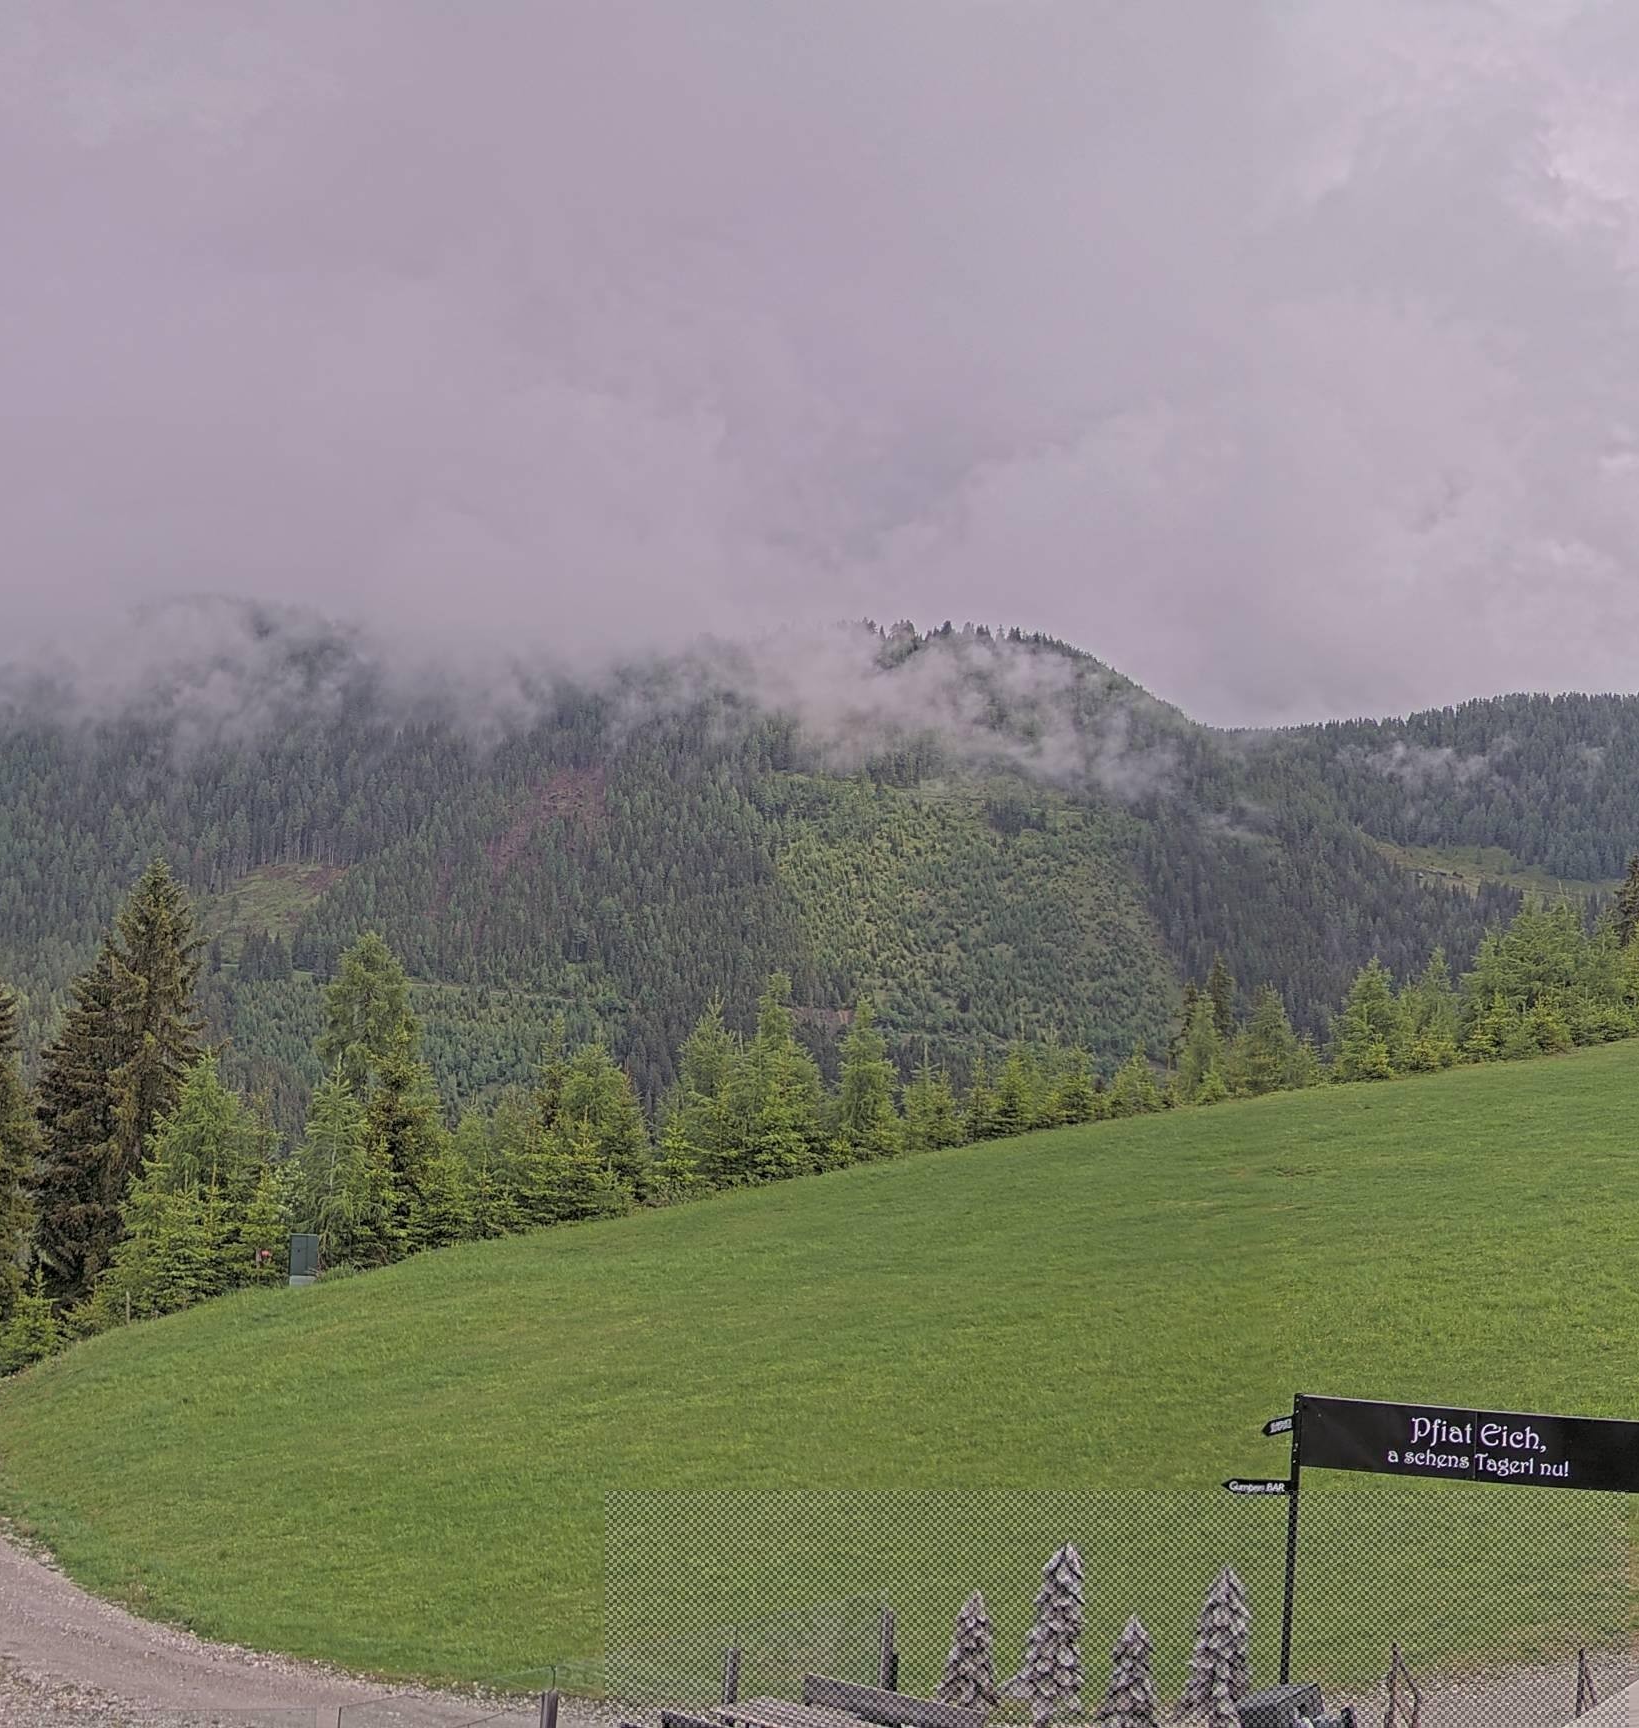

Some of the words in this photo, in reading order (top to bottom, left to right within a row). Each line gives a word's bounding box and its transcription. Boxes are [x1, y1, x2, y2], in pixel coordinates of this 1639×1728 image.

[1411, 1417, 1472, 1447] Pfiat
[1480, 1423, 1547, 1453] Eich,
[1387, 1450, 1399, 1463] a
[1404, 1449, 1470, 1469] schens
[1474, 1454, 1534, 1477] Tagerl
[1539, 1461, 1570, 1477] nu!
[1266, 1483, 1285, 1492] BAR
